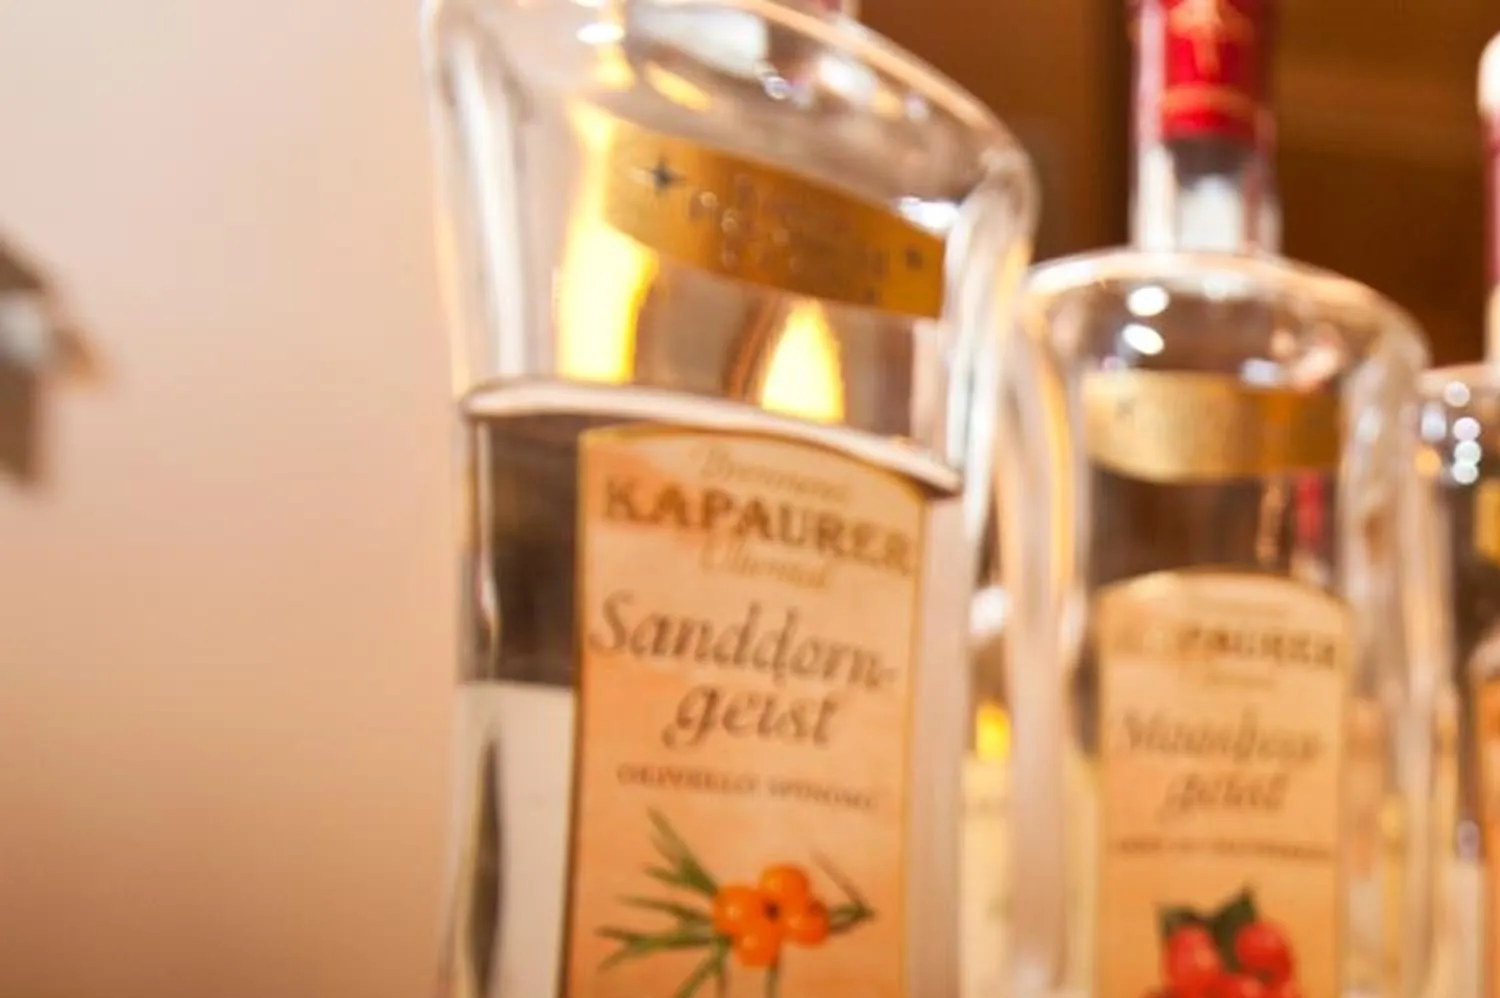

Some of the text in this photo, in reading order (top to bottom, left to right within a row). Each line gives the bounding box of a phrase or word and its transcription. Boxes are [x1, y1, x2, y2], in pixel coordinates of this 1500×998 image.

[604, 472, 915, 576] KAPAURER
[588, 588, 900, 692] Sanddorn-
[661, 683, 840, 750] geist
